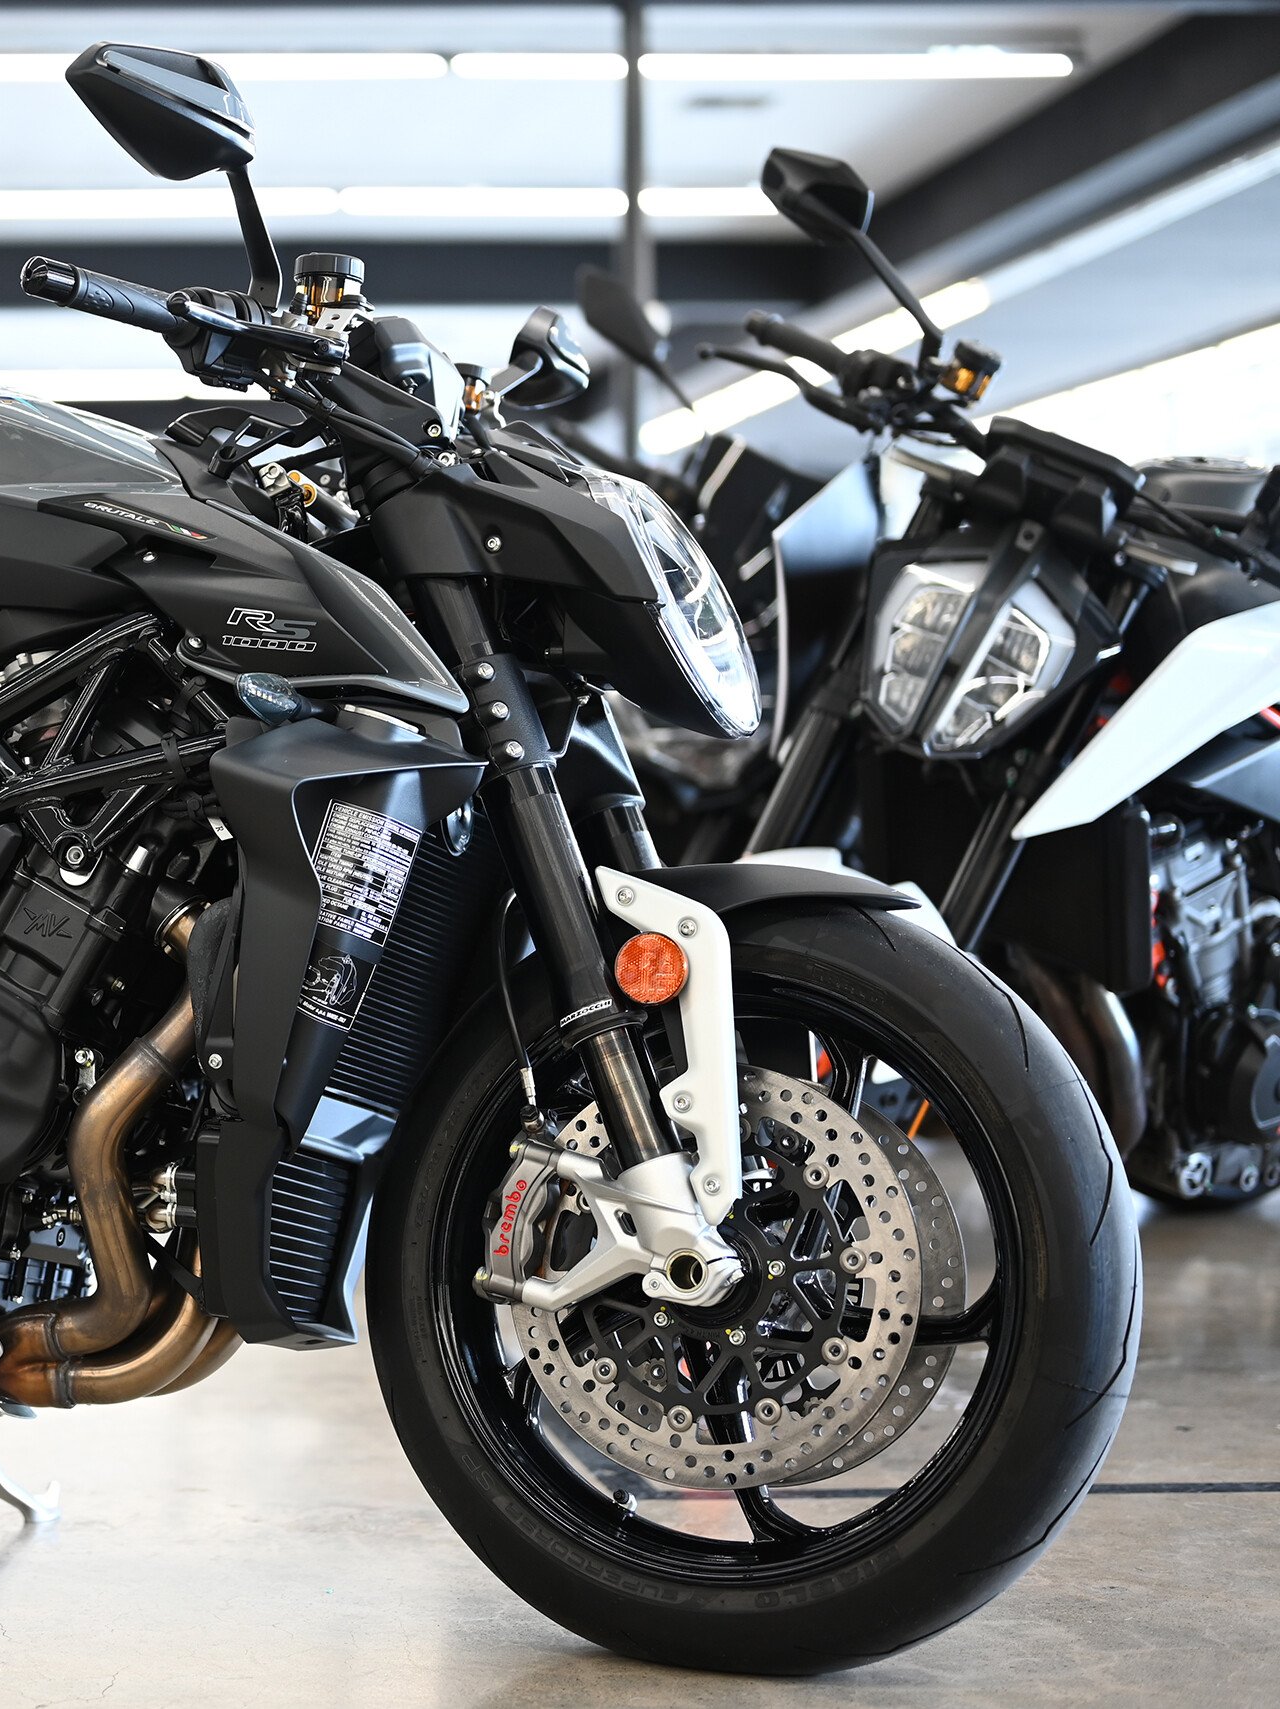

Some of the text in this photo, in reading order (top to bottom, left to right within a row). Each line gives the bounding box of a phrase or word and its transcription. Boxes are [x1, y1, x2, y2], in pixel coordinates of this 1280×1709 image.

[84, 502, 160, 526] BRUTALE
[227, 607, 317, 639] RS
[222, 635, 318, 653] 1000
[334, 805, 358, 817] VEHICLE
[358, 812, 384, 826] EMISSION
[494, 1180, 527, 1257] brembo
